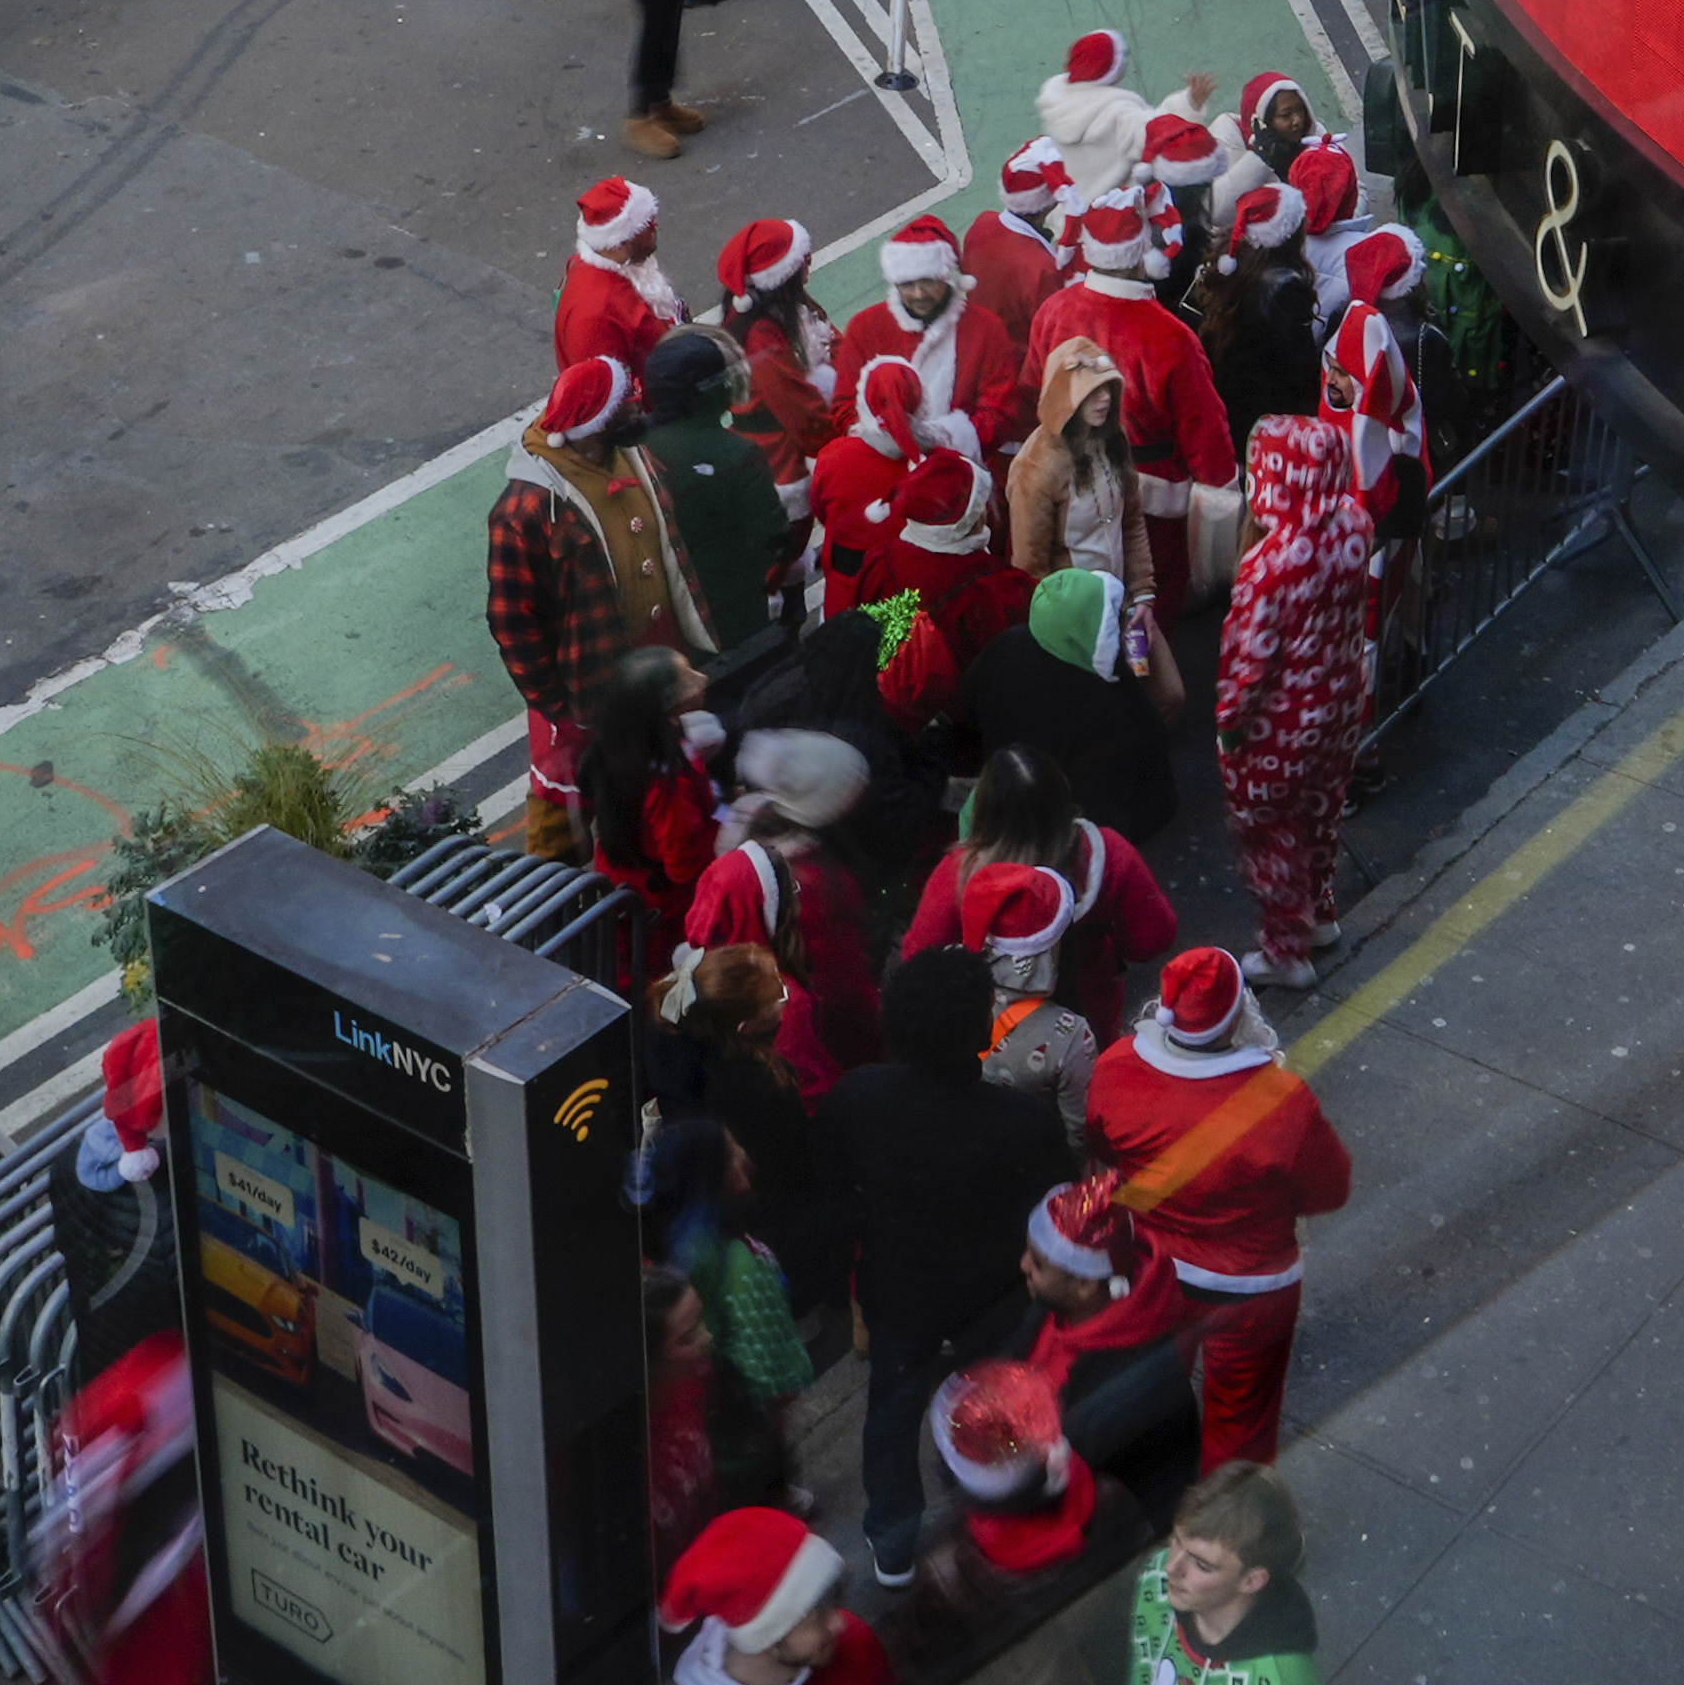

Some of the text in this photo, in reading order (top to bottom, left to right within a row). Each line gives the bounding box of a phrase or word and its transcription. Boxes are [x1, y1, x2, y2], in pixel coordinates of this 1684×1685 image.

[1534, 139, 1590, 339] &
[334, 1010, 452, 1093] LinkNYC
[228, 1171, 283, 1214] $41/day
[371, 1238, 433, 1284] $42/day
[241, 1437, 358, 1532] Rethink
[364, 1518, 433, 1574] your
[244, 1483, 331, 1552] rental
[337, 1539, 386, 1583] car
[261, 1581, 319, 1632] TURO
